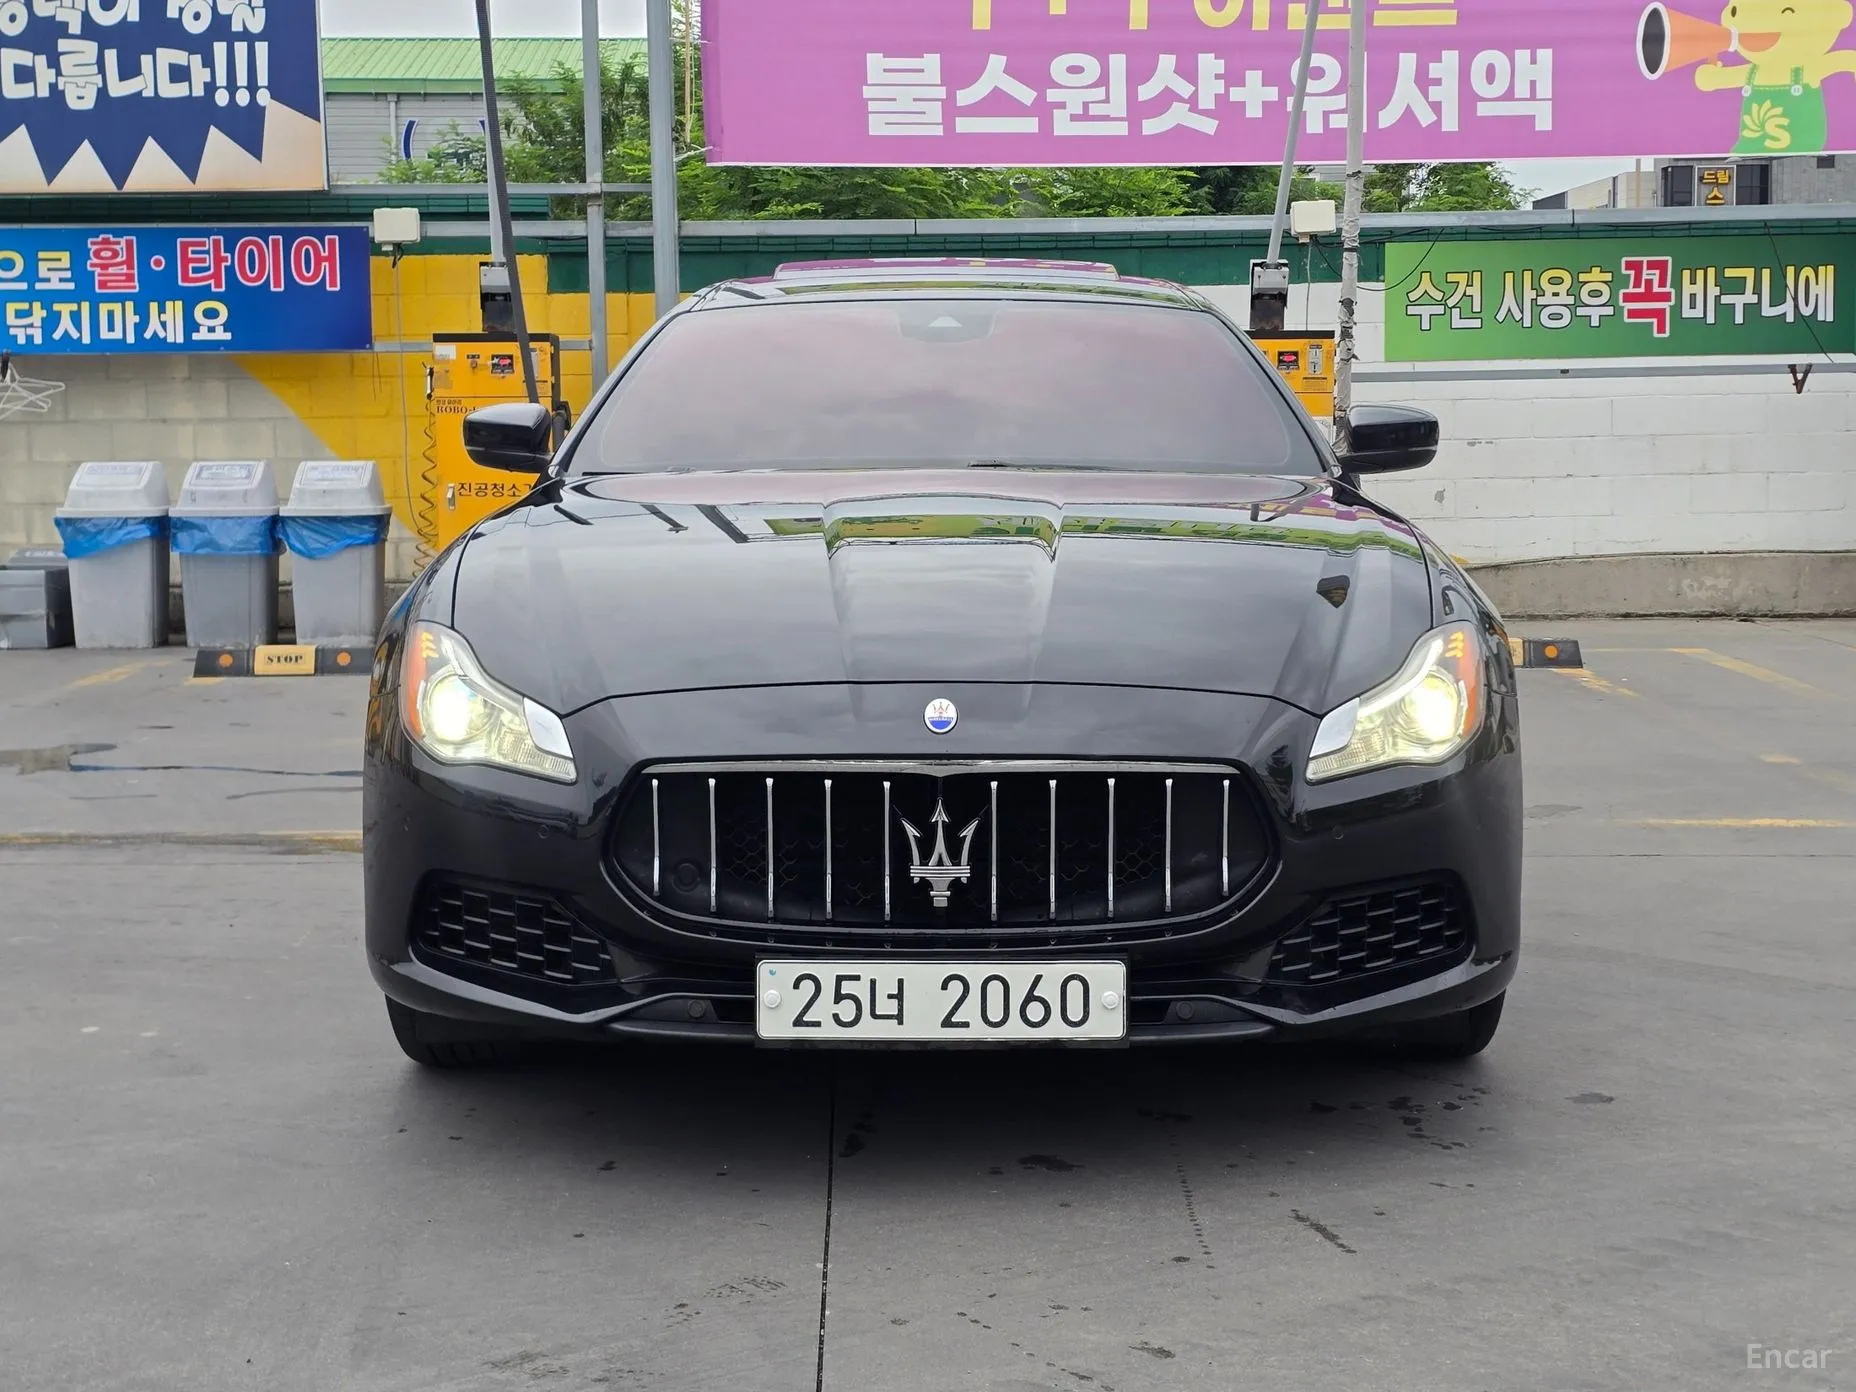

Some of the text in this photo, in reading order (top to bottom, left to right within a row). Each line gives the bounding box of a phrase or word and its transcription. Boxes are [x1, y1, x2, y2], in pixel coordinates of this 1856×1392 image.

[0, 39, 271, 110] 다릅니다!!!
[1702, 170, 1729, 184] 드림
[1406, 256, 1835, 337] 수건 사용후 꼭 바구니에
[5, 300, 232, 344] 닦지마세요
[266, 655, 303, 665] STOP
[792, 973, 1090, 1028] 25너 2060
